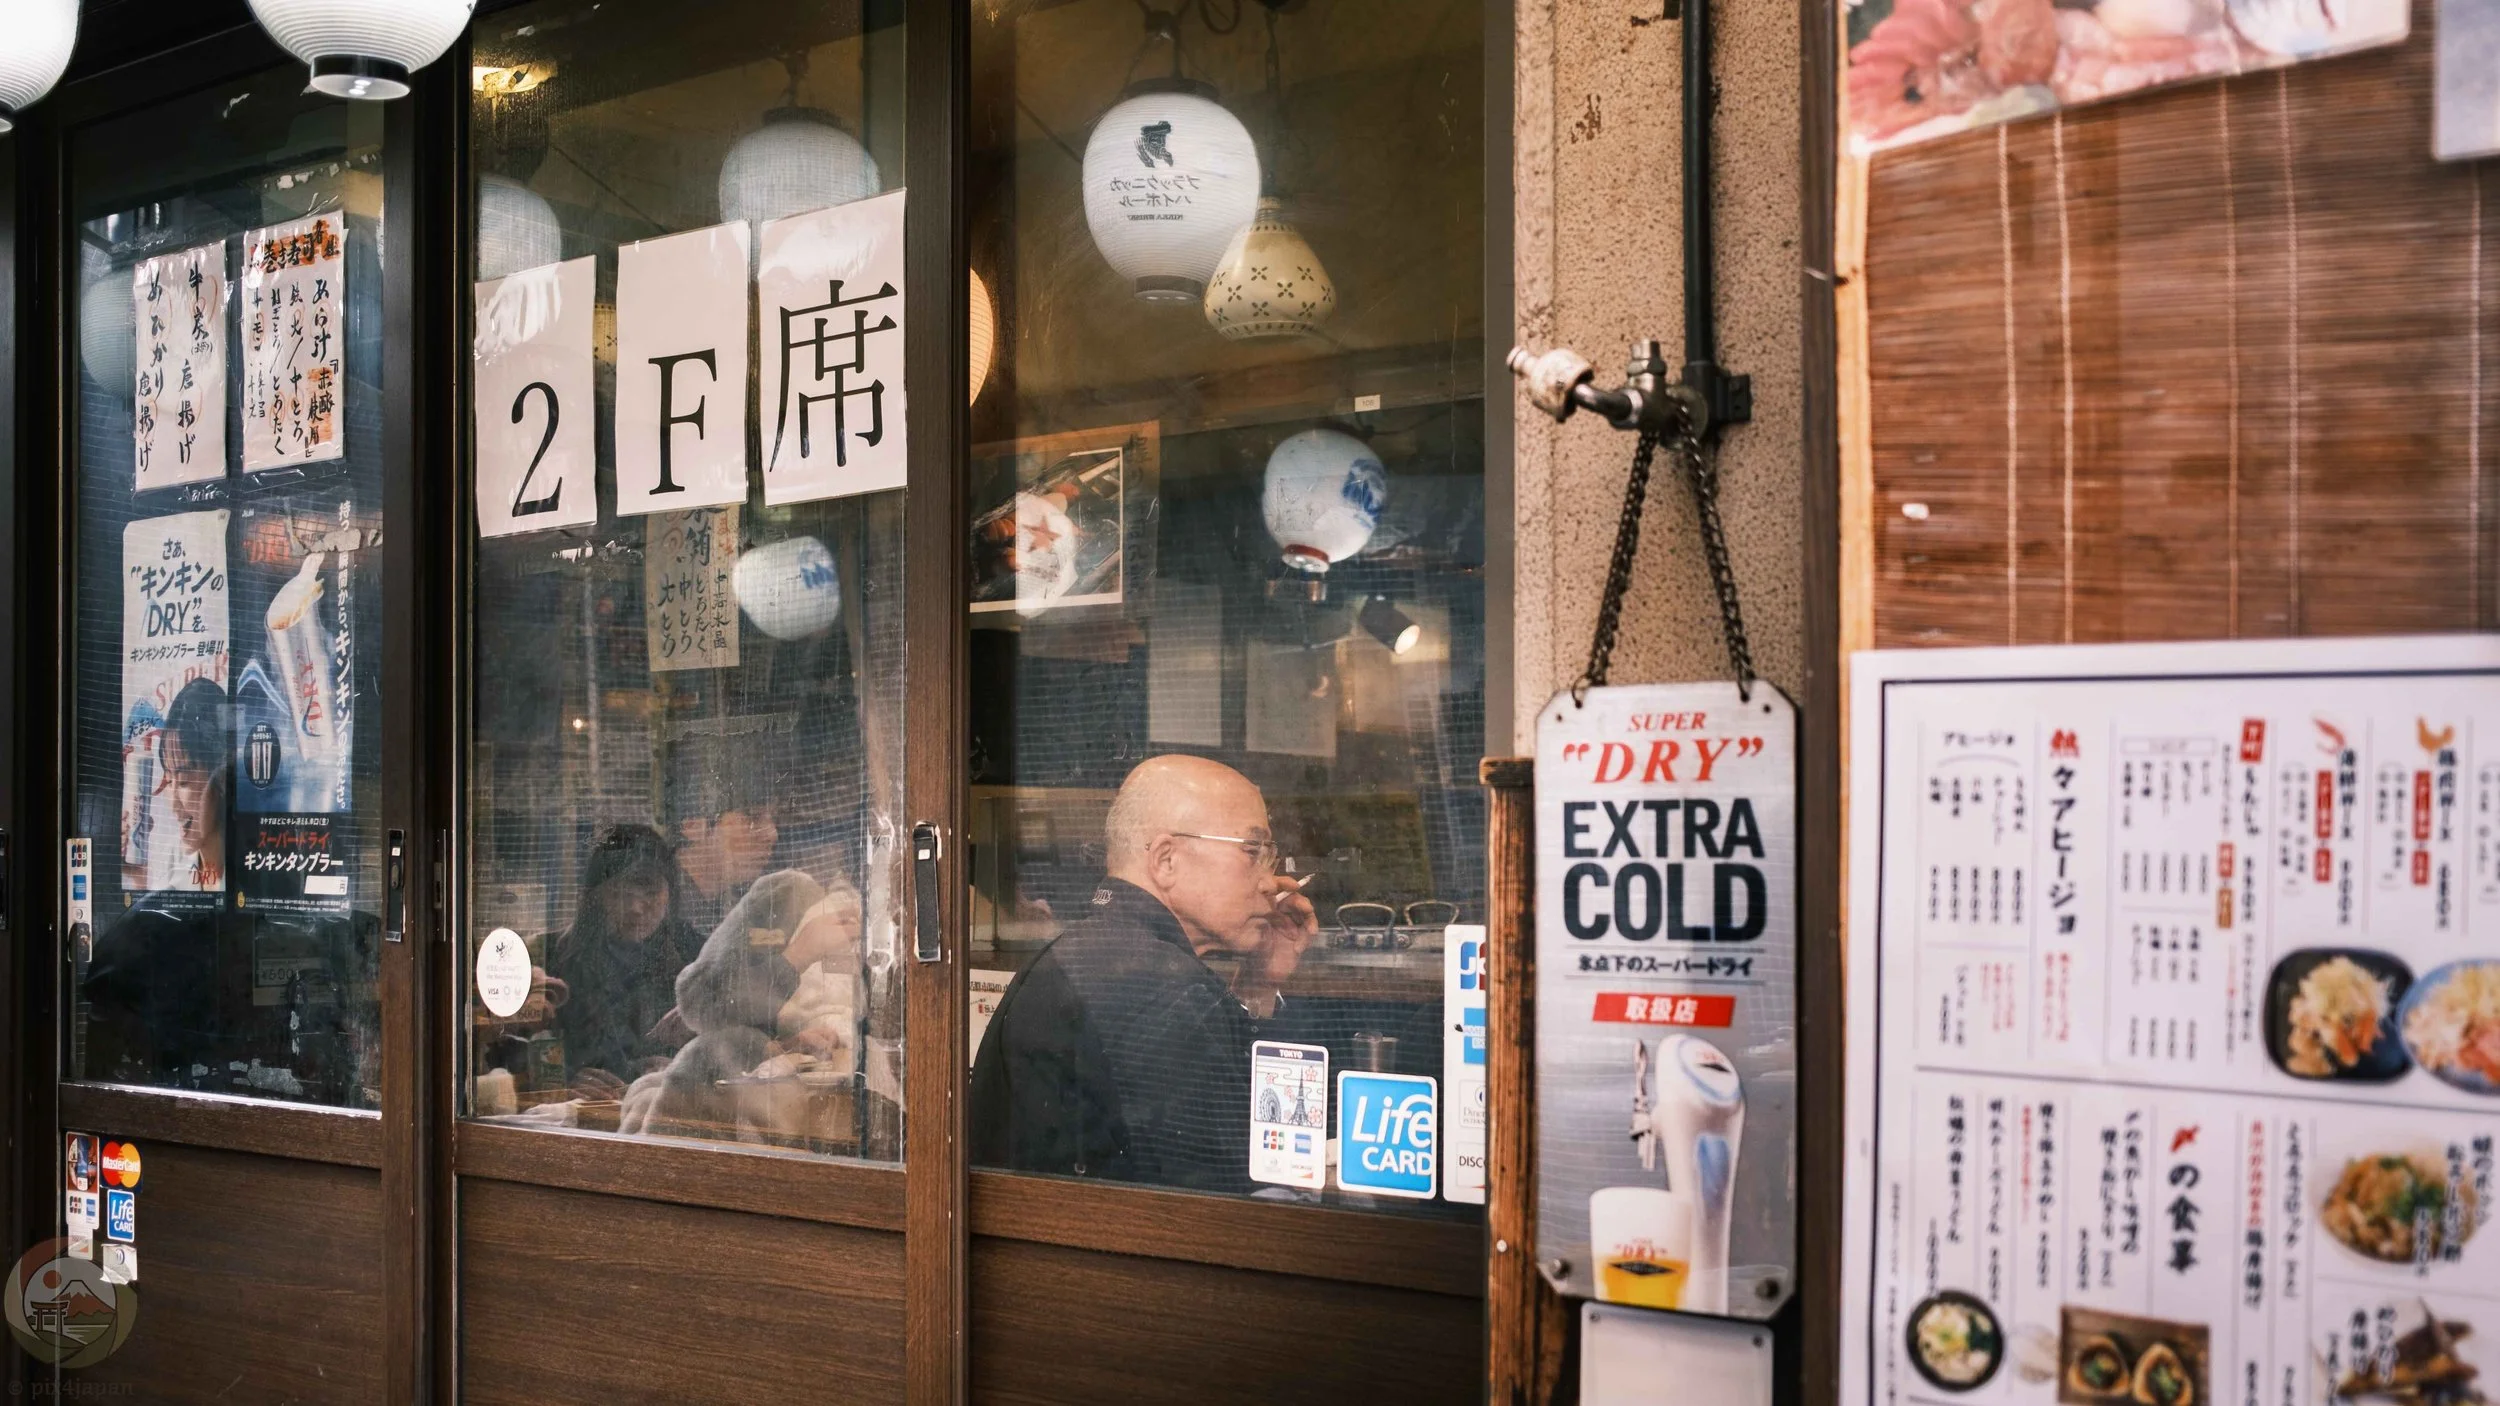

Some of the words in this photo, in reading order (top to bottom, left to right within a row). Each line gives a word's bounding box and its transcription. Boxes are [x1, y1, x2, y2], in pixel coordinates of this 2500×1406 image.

[162, 537, 186, 561] さあ、
[130, 643, 196, 663] キンキンタンブラー
[1628, 711, 1707, 732] SUPER
[1562, 736, 1765, 784] “DRY”
[1563, 797, 1766, 859] EXTRA
[257, 831, 331, 850] スーパードライ
[244, 850, 344, 873] キンキンタンブラー
[1563, 862, 1768, 941] COLD
[1577, 955, 1754, 977] 氷点下のスーパードライ
[487, 987, 499, 995] VISA
[1624, 996, 1699, 1024] 取扱店
[1279, 1048, 1303, 1060] TOKYO
[1351, 1093, 1432, 1147] Life
[102, 1156, 141, 1173] MasterCard
[1361, 1146, 1432, 1176] CARD
[1458, 1156, 1486, 1168] DISC
[110, 1199, 133, 1222] Life
[113, 1220, 133, 1233] CARD
